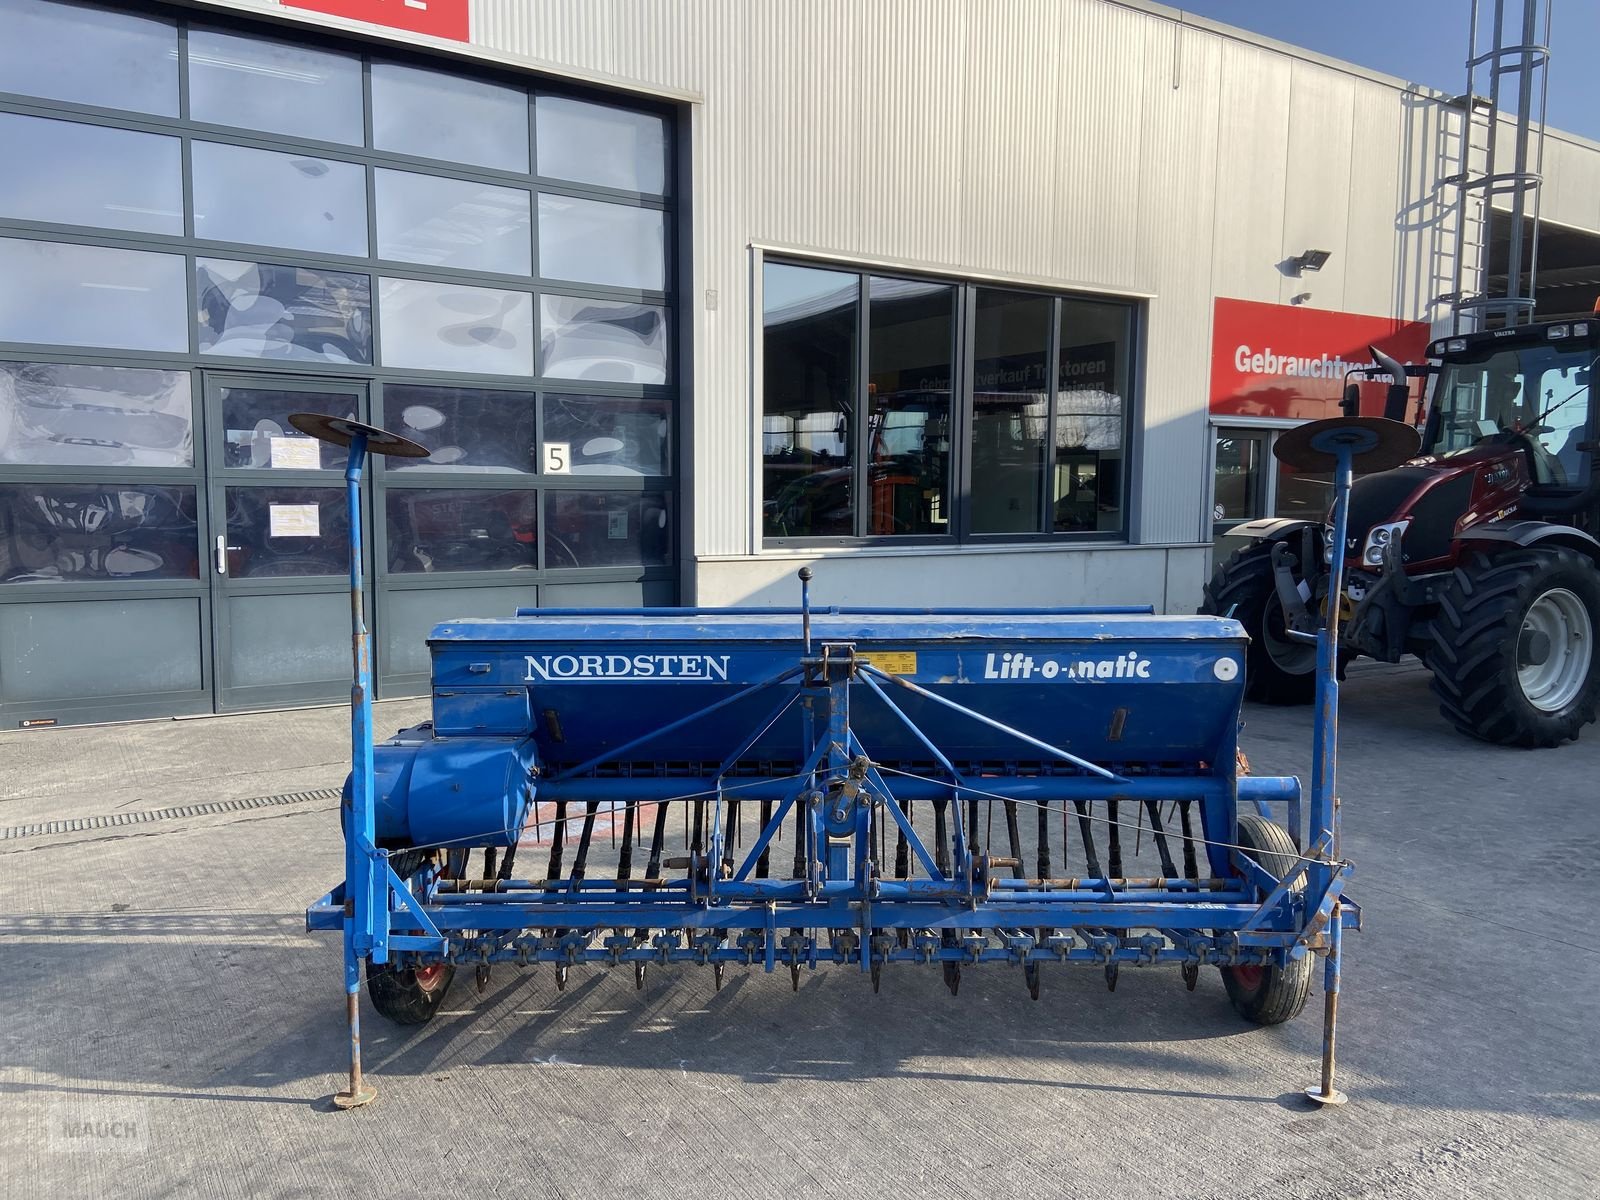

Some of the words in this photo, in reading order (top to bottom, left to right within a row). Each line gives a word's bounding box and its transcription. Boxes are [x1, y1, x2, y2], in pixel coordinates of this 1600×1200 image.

[550, 447, 563, 471] 5
[524, 655, 731, 681] NORDSTEN
[984, 651, 1152, 679] Lift-o-matic
